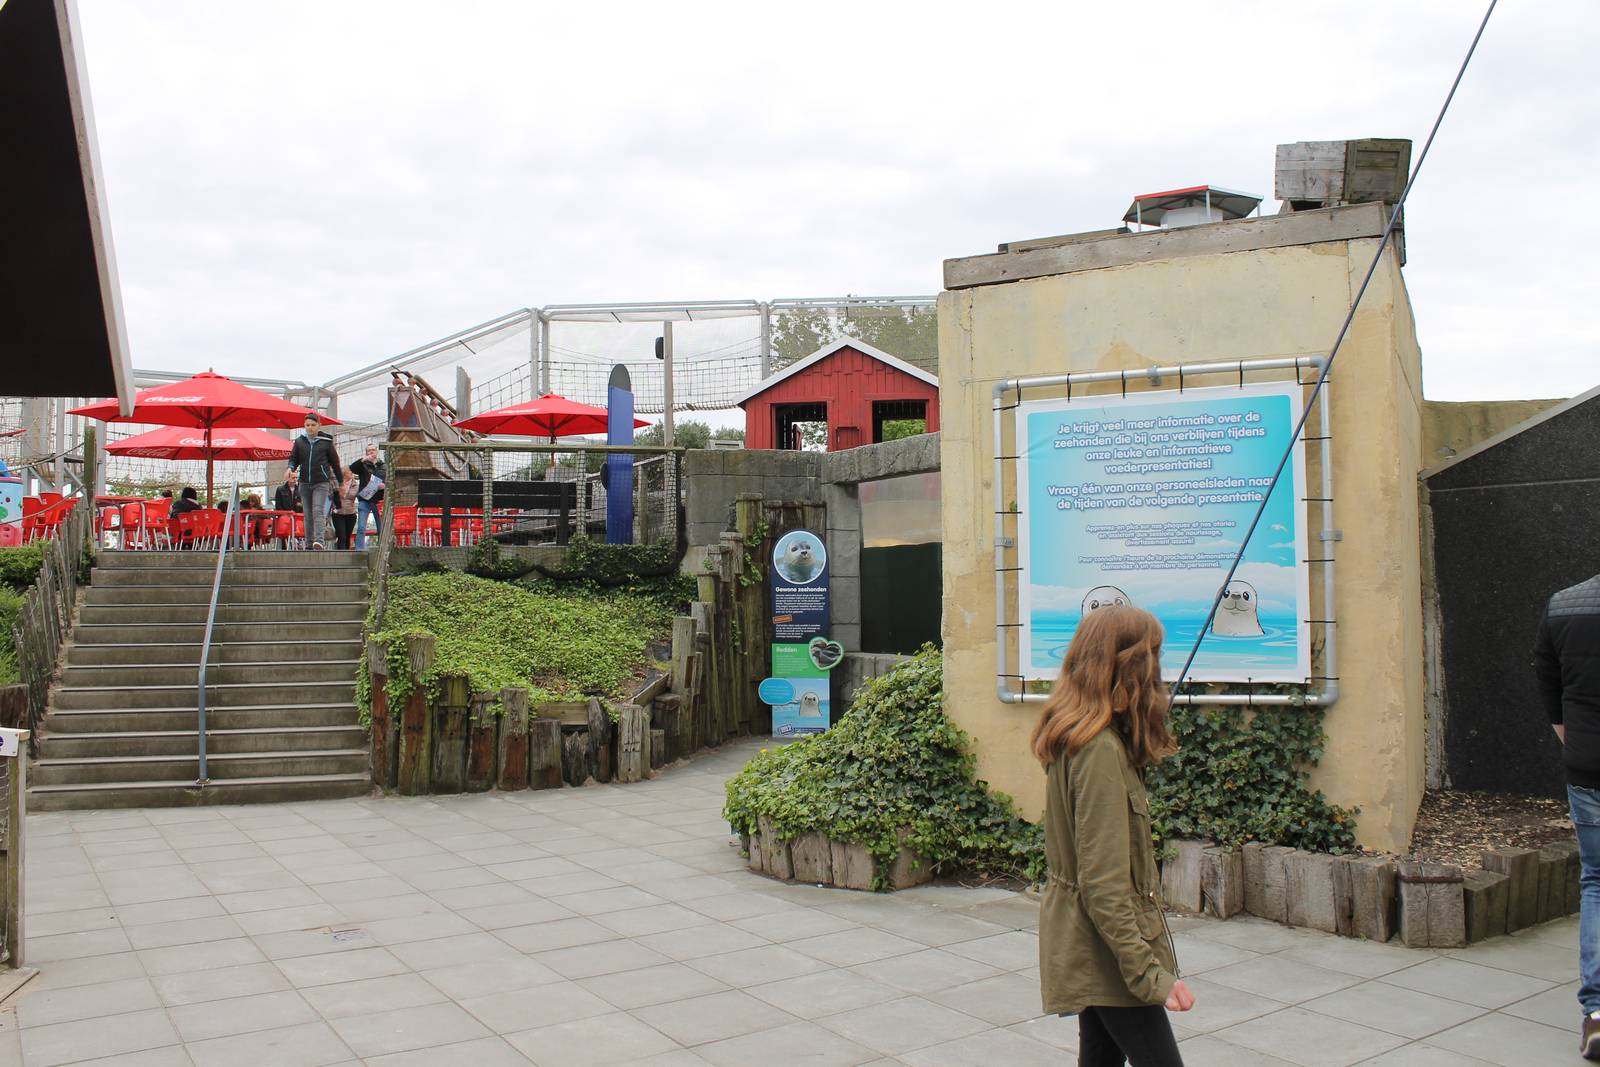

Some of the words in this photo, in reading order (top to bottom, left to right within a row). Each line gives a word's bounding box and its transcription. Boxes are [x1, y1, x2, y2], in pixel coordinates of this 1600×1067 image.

[1058, 424, 1070, 434] Je
[1073, 422, 1100, 434] krijgt
[1102, 419, 1124, 431] veel
[1127, 420, 1156, 429] meer
[1158, 415, 1215, 427] informatie
[1217, 415, 1242, 424] over
[1245, 411, 1260, 422] de
[1054, 436, 1112, 448] zeehonden
[1115, 434, 1131, 444] die
[1134, 432, 1147, 445] bij
[1150, 433, 1169, 442] ons
[1172, 429, 1224, 441] verblijven
[1227, 427, 1265, 439] tijdens
[1086, 451, 1111, 460] onze
[1113, 448, 1142, 459] leuke
[1145, 448, 1159, 457] en
[1162, 443, 1232, 456] informatieve
[1105, 459, 1212, 474] voederpresentaties!
[1047, 486, 1079, 497] Vraag
[1081, 483, 1101, 494] één
[1104, 484, 1124, 493] van
[1126, 483, 1153, 492] onze
[1155, 477, 1245, 493] personeelsleden
[1057, 498, 1071, 509] de
[1073, 498, 1103, 511] tijden
[1106, 498, 1125, 507] van
[1128, 495, 1143, 506] de
[1145, 494, 1195, 507] volgende
[1198, 491, 1265, 506] presentatie.
